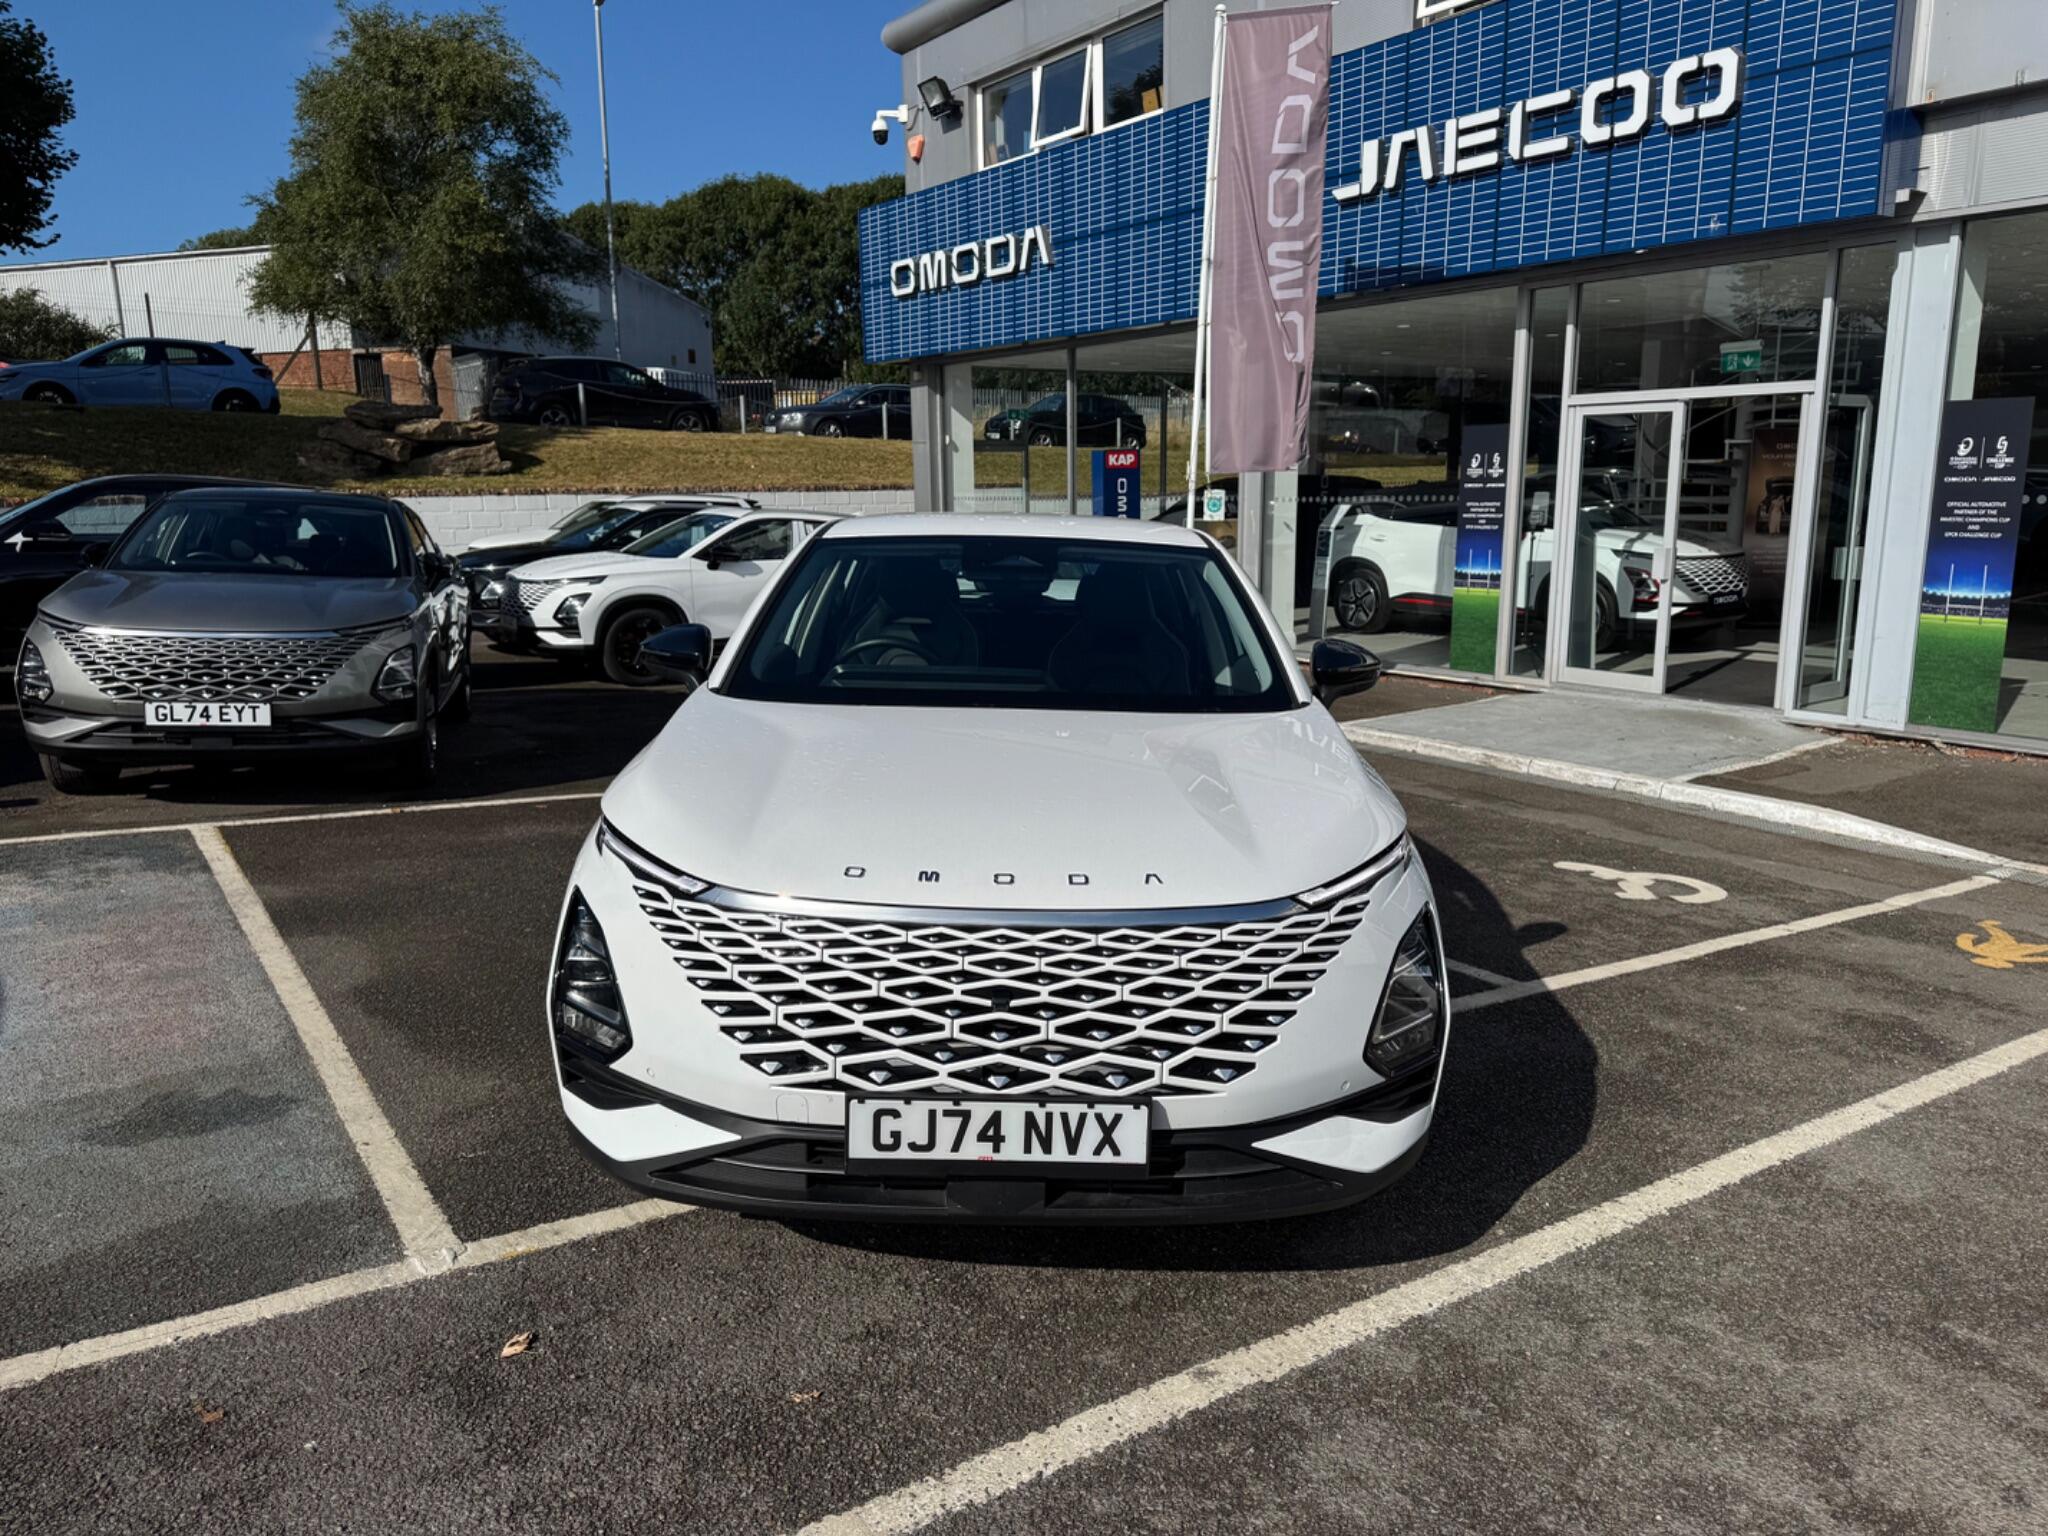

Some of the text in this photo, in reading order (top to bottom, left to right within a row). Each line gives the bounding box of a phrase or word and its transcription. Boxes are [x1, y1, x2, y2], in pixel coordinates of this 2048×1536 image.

[1332, 46, 1740, 201] JAECOO
[1267, 25, 1319, 362] OMODA
[890, 224, 1050, 298] OMODA
[1107, 453, 1136, 467] KAP
[1116, 477, 1128, 519] OM
[154, 704, 260, 723] GL74 EYT
[843, 865, 1164, 886] OMODA
[872, 1108, 1124, 1157] GJ74 NVX
